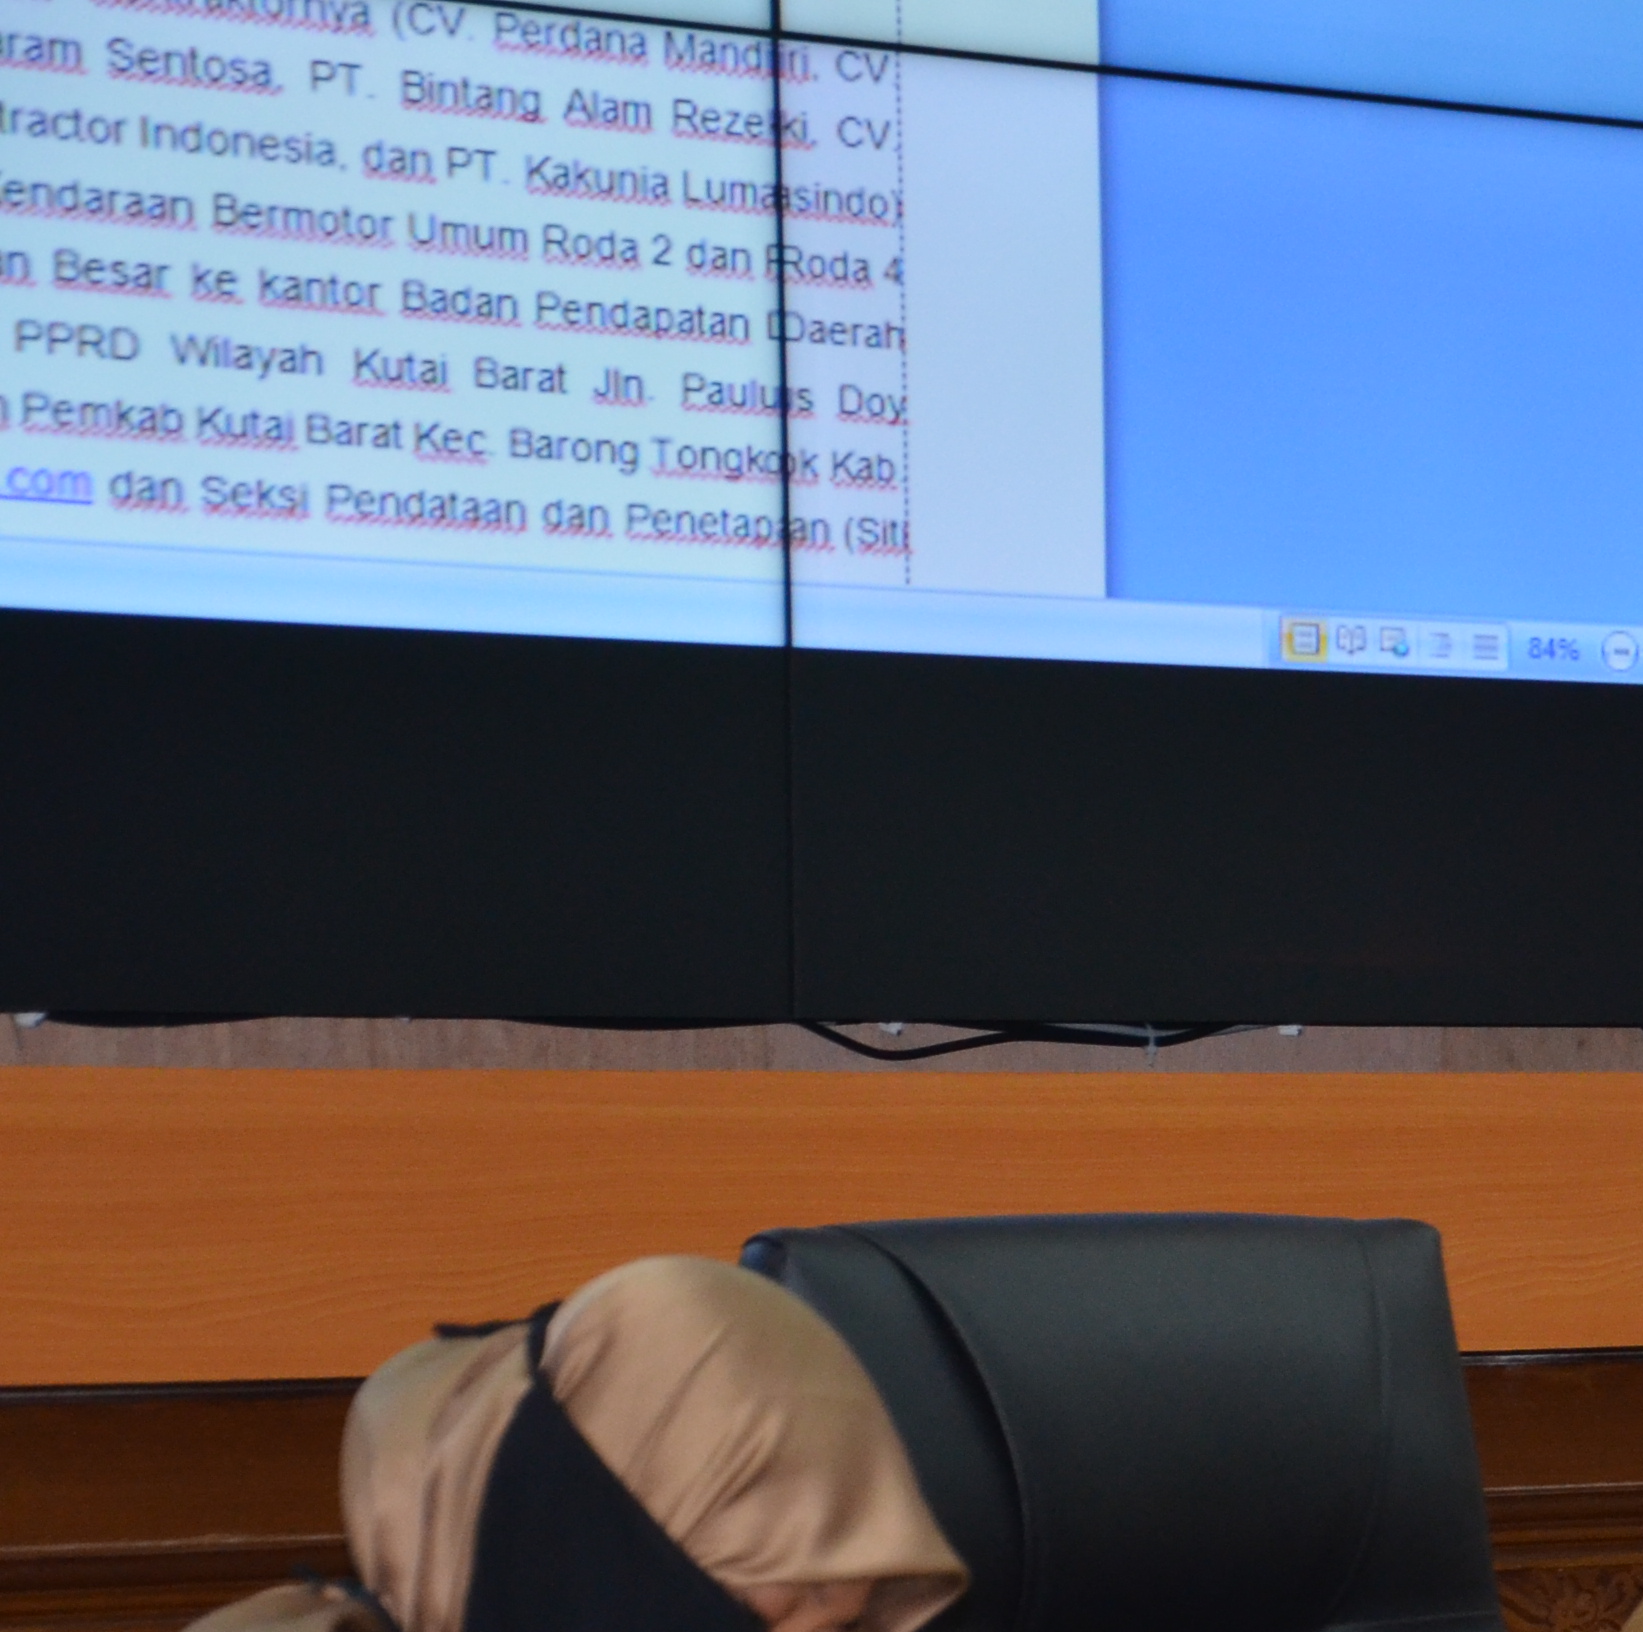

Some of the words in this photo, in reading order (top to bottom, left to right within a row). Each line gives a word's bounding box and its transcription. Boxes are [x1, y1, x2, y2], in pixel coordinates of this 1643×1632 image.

[0, 29, 83, 67] ram
[401, 69, 542, 122] Bintang
[562, 87, 653, 128] Alam
[495, 11, 648, 58] Perdana
[362, 140, 432, 177] dan
[524, 154, 670, 201] Kakunia
[0, 170, 194, 223] endaraan
[211, 191, 394, 240] Bermotor
[407, 210, 529, 252] Umum
[542, 222, 640, 264] Roda
[651, 233, 674, 266] 2
[686, 241, 751, 273] dan
[766, 242, 871, 284] Roda
[883, 256, 902, 284] 4
[53, 248, 171, 290] Besar
[191, 261, 238, 297] ke
[258, 267, 382, 309] kantor
[401, 278, 518, 321] Badan
[535, 289, 751, 343] Pendapatan
[766, 309, 906, 351] Daerah
[14, 318, 141, 362] PPRD
[169, 332, 325, 381] Wilayah
[353, 346, 449, 387] Kutai
[473, 355, 568, 395] Barat
[681, 371, 815, 413] Paulus
[839, 383, 907, 426] Doy
[22, 390, 184, 435] Pemkab
[198, 406, 296, 443] Kutai
[305, 412, 402, 450] Barat
[509, 427, 640, 476] Barong
[652, 436, 819, 481] Tongkok
[109, 470, 184, 504] dan
[201, 474, 310, 512] Seksi
[327, 483, 526, 530] Pendataan
[542, 498, 610, 533] dan
[1527, 636, 1580, 661] 84%
